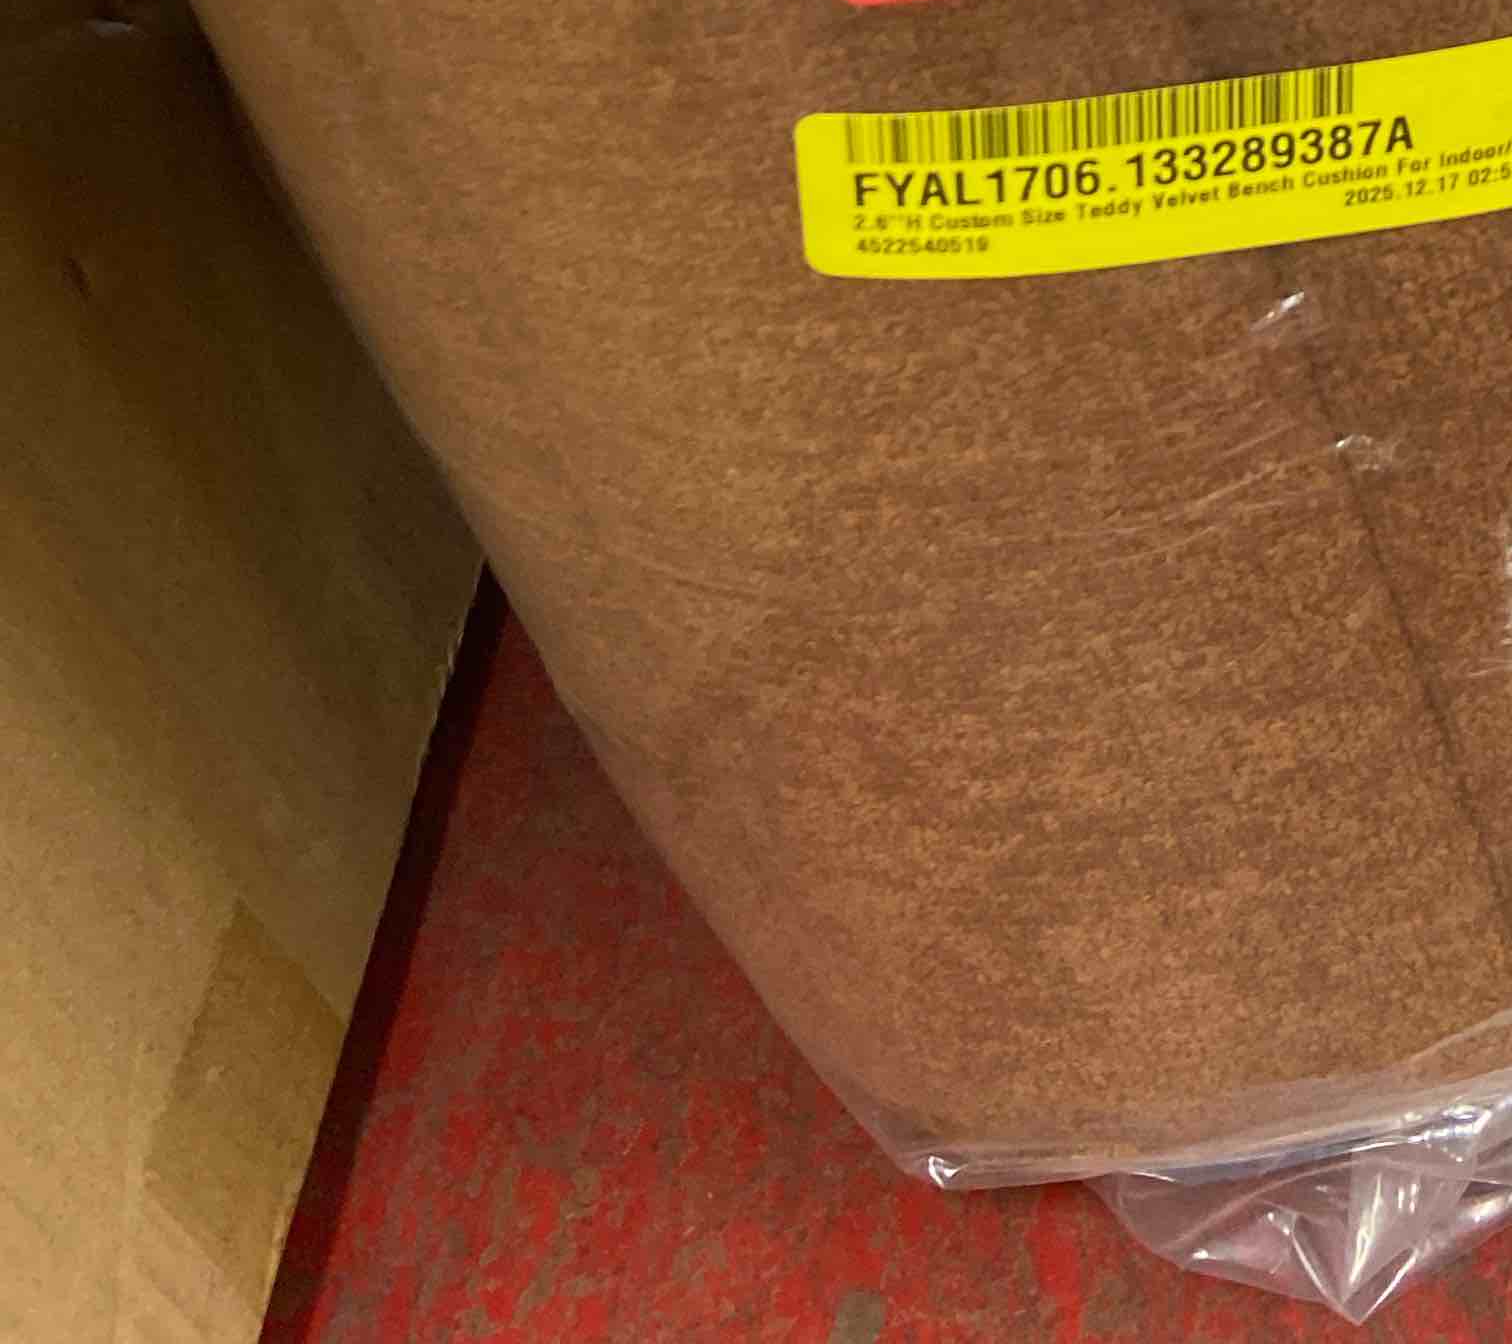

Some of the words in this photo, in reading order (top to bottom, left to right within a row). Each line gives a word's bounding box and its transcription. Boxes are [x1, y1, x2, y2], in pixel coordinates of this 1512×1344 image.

[853, 115, 1414, 207] FYAL1706.133289387A
[929, 212, 1014, 230] Custom
[1020, 208, 1065, 225] Size
[1075, 197, 1144, 220] Teddy
[1152, 187, 1220, 209] Velvet
[1228, 175, 1295, 199] Bench
[1303, 162, 1388, 188] Cushion
[1397, 156, 1432, 177] For
[1344, 171, 1460, 207] 2025.12.17
